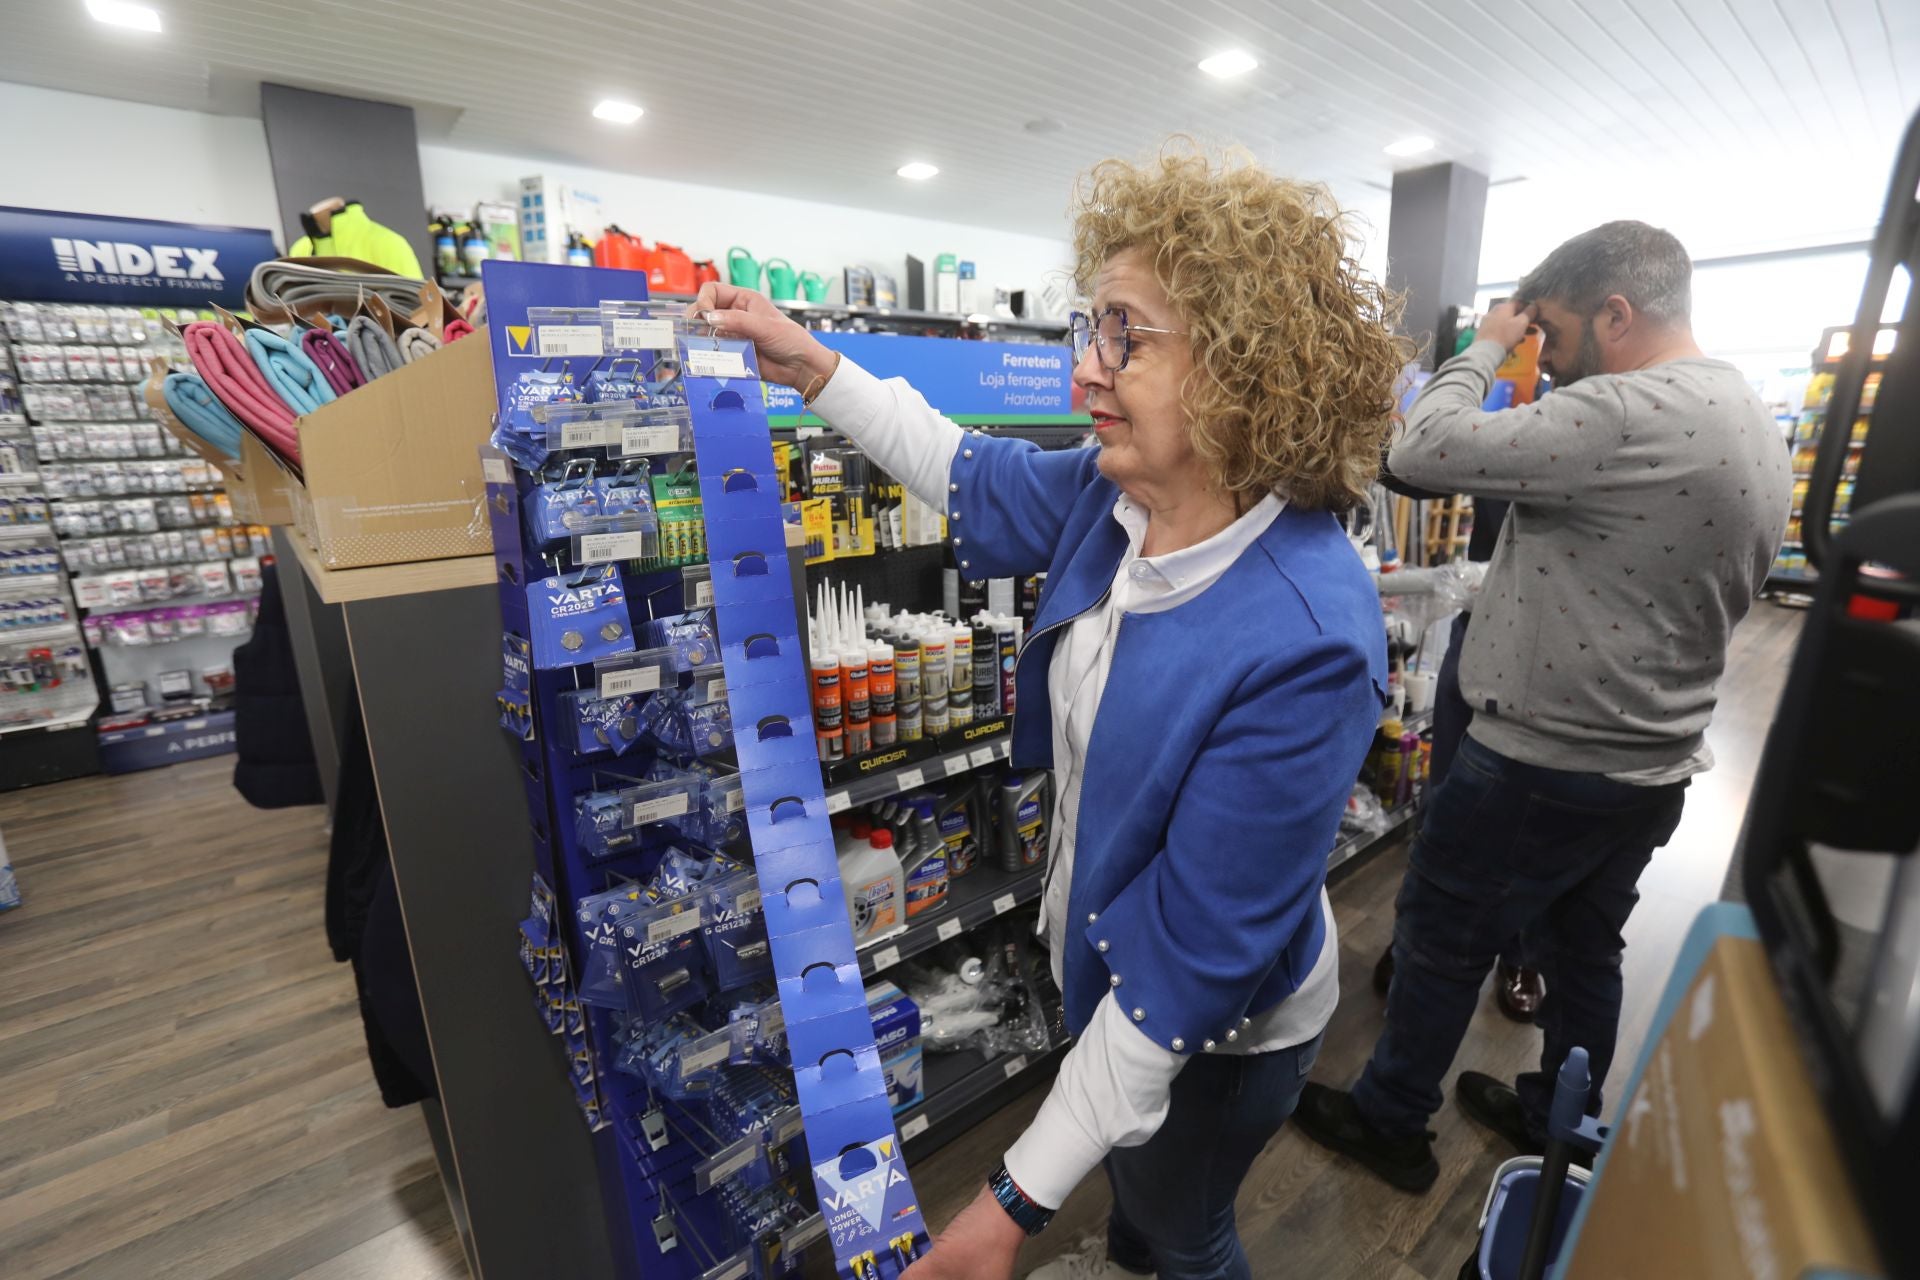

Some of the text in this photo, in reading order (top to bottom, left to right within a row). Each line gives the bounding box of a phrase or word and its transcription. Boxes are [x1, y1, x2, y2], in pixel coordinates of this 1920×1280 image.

[51, 237, 225, 281] INDEX
[65, 273, 224, 291] A PERFECT FIXING
[1002, 352, 1061, 369] Ferretería
[596, 382, 647, 393] VARTA
[980, 371, 1062, 390] Loja ferragens
[518, 385, 571, 395] VARTA
[1004, 392, 1062, 406] Hardware
[812, 476, 840, 486] NURAL
[544, 489, 596, 503] VARTA
[601, 489, 649, 504] VARTA
[548, 583, 621, 605] VARTA
[551, 600, 595, 614] CR2025
[504, 653, 529, 674] VARTA
[597, 696, 631, 723] VARTA
[688, 704, 728, 720] VARTA
[167, 741, 182, 753] A
[921, 860, 944, 873] PASO
[714, 918, 751, 933] CR123A
[632, 946, 669, 969] CR123A
[823, 1168, 907, 1212] VARTA
[749, 1199, 798, 1232] VARTA
[829, 1201, 872, 1225] LONGLIFE
[832, 1216, 861, 1234] POWER
